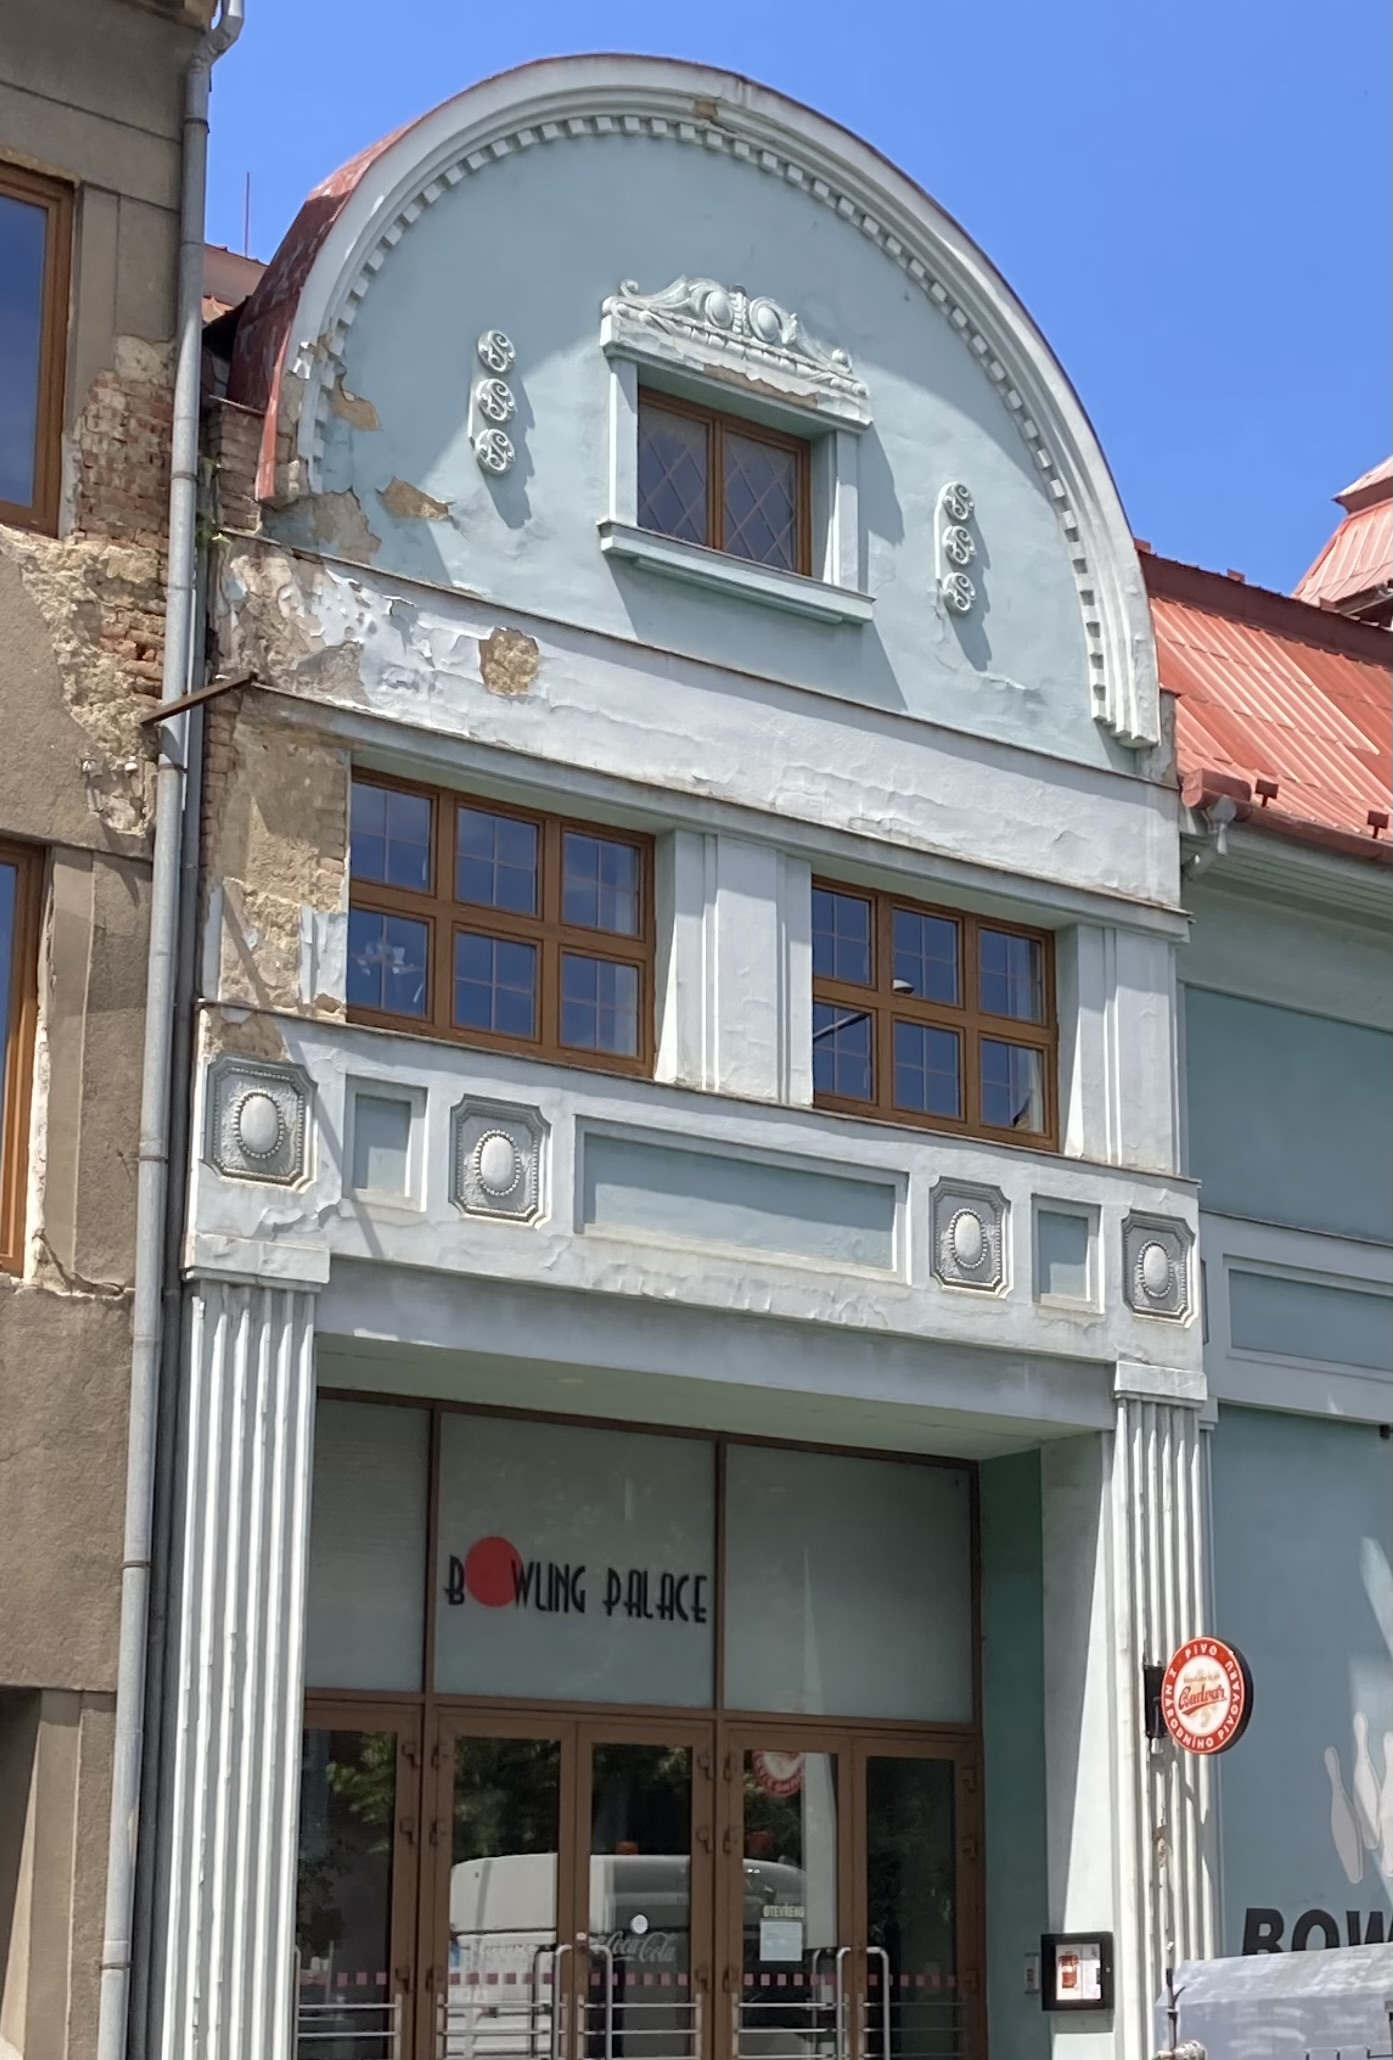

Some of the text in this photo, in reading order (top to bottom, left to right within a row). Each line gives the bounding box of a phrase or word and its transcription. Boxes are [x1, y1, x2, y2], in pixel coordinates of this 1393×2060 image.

[602, 1567, 708, 1624] PALACE
[1184, 1642, 1218, 1659] PIVO
[1217, 1660, 1241, 1740] PIVOVARU
